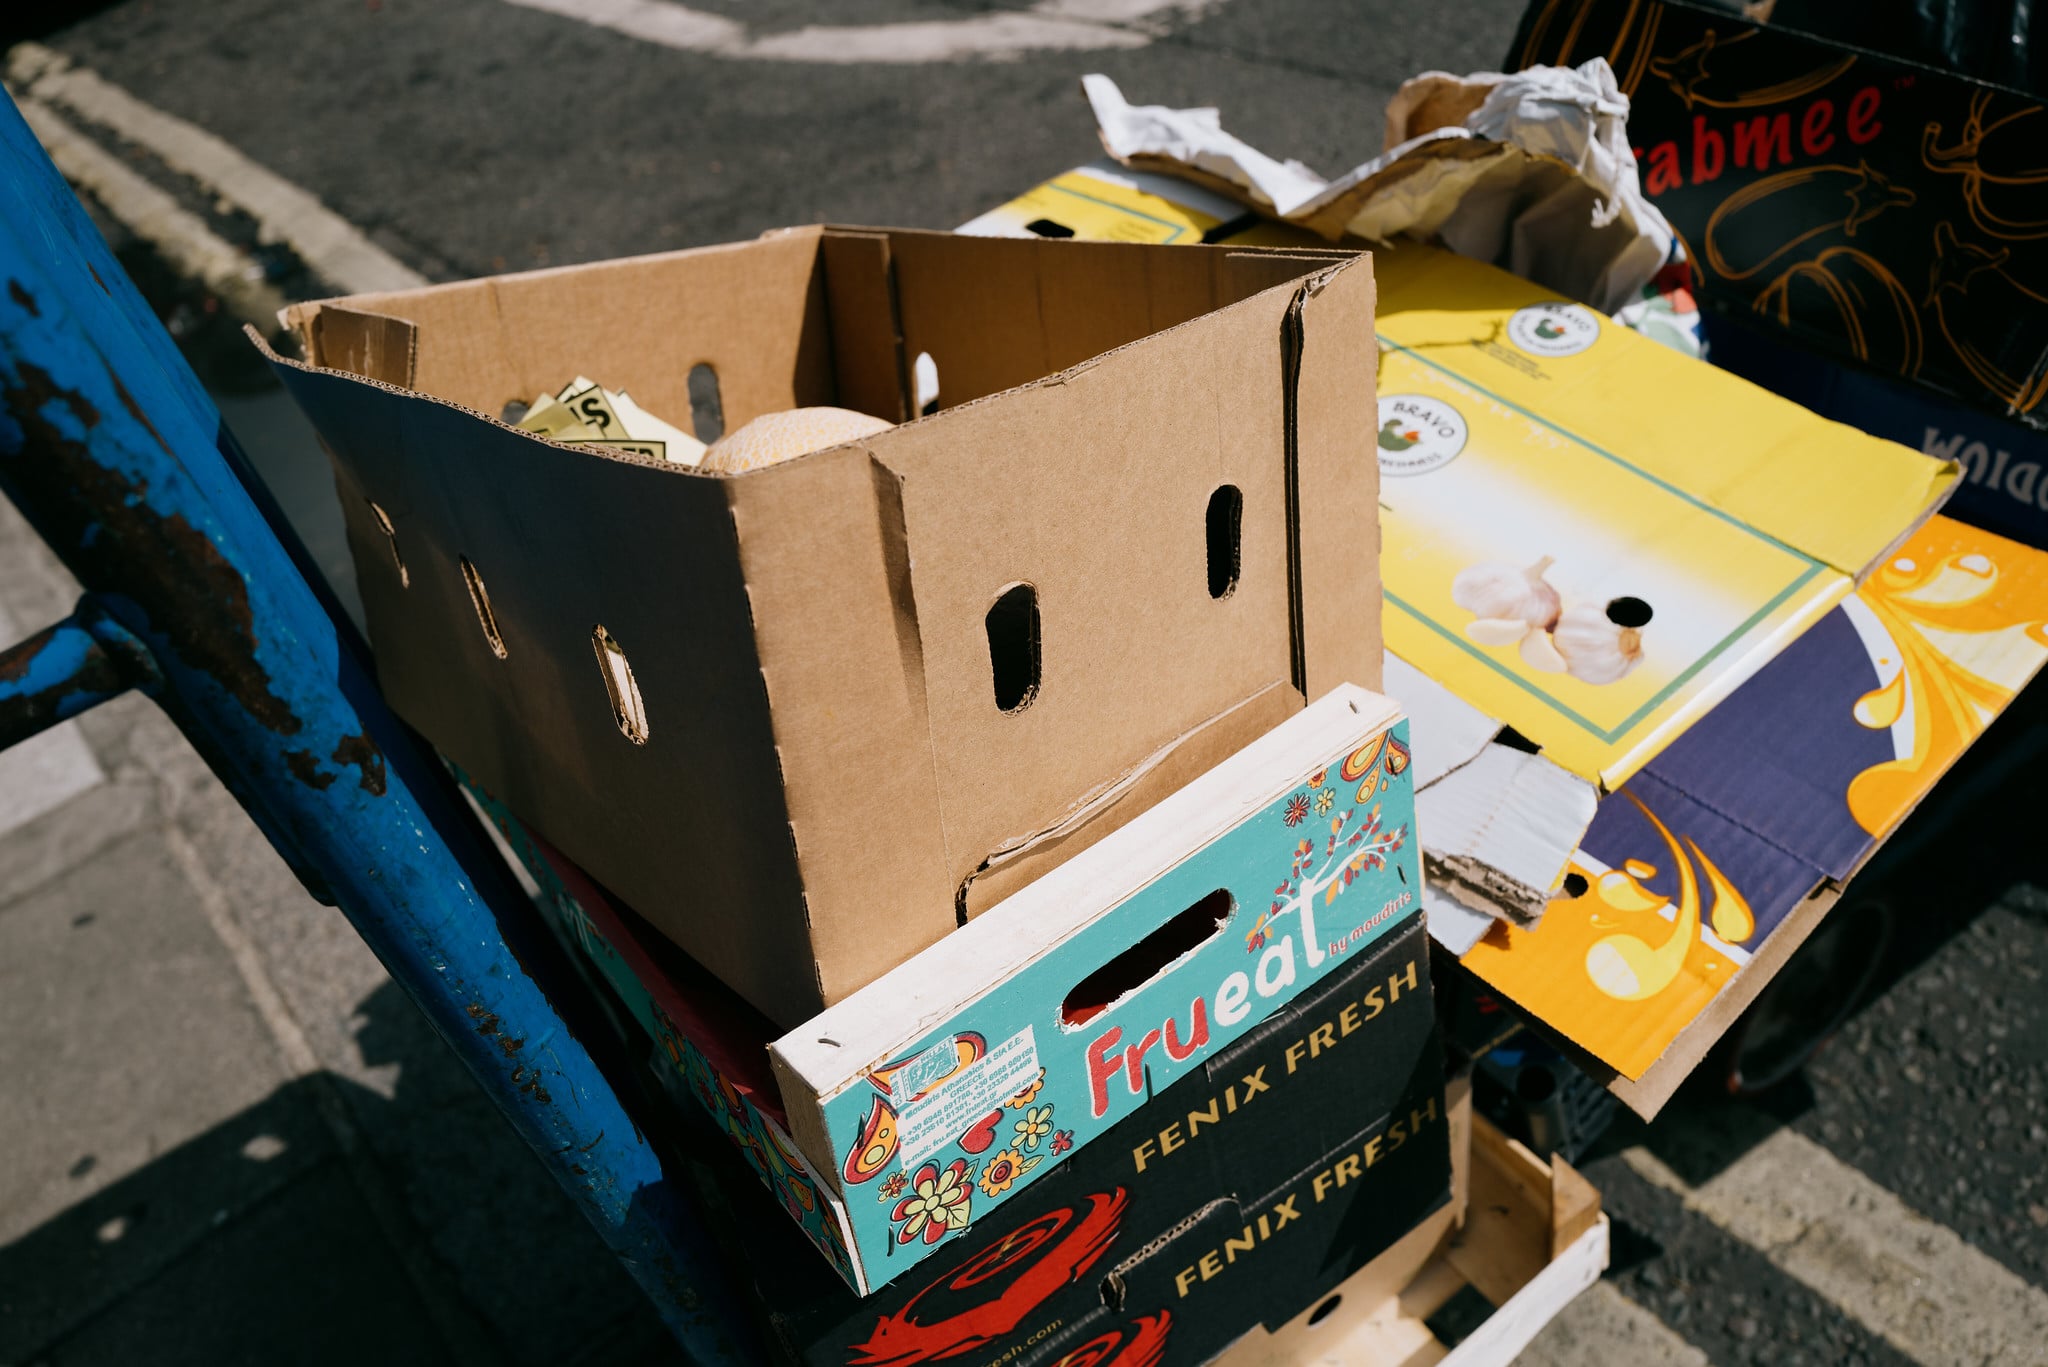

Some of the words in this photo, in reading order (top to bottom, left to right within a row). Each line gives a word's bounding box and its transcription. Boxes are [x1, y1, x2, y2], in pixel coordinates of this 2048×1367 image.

[1633, 86, 1883, 196] abmee
[1393, 401, 1455, 438] BRAVO
[1329, 940, 1348, 958] by
[1351, 891, 1413, 941] moudiris
[1086, 870, 1330, 1119] Frueat
[904, 1091, 940, 1120] Moudiris
[941, 1063, 984, 1094] Athanasios
[985, 1056, 992, 1066] &
[949, 1071, 984, 1098] GREECE
[1132, 1065, 1270, 1174] FENIX
[1284, 960, 1418, 1075] FRESH
[908, 1122, 921, 1136] +30
[945, 1091, 997, 1129] www.frueat.gr
[1174, 1193, 1302, 1299] FENIX
[1312, 1097, 1438, 1203] FRESH
